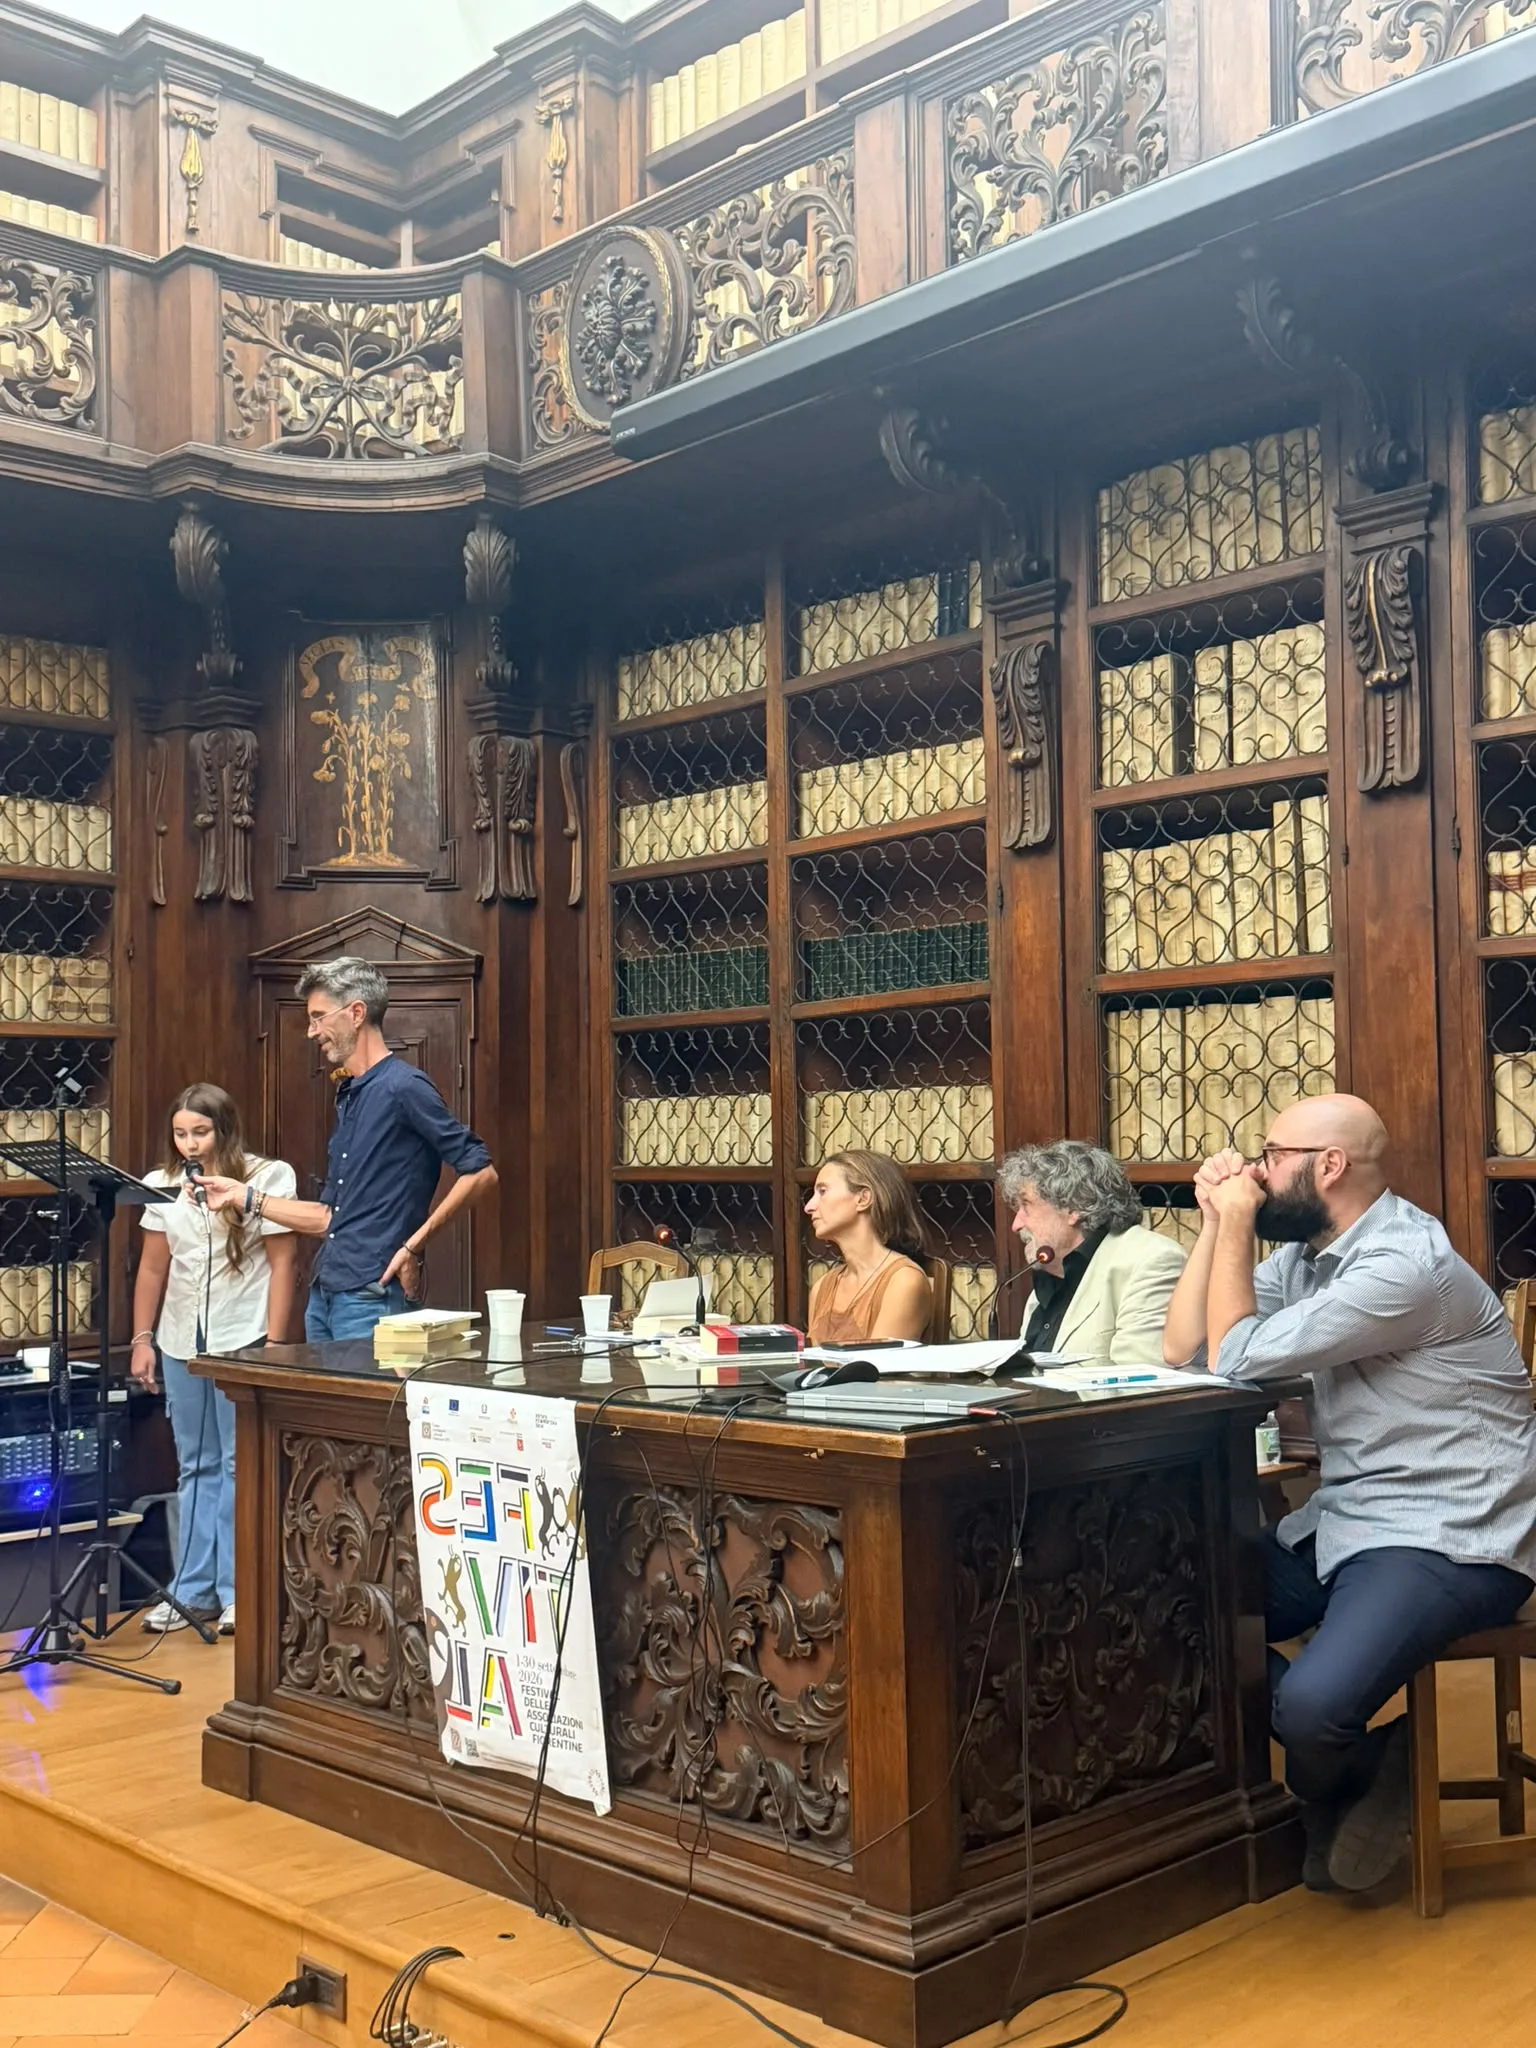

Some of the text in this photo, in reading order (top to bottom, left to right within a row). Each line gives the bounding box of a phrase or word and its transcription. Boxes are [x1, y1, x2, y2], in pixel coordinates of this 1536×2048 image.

[516, 1654, 577, 1680] 1-30 settbre
[518, 1669, 543, 1685] 2026
[521, 1684, 560, 1700] FESTIV
[524, 1697, 550, 1710] DELLE
[527, 1709, 584, 1730] ASSOIAZIONI
